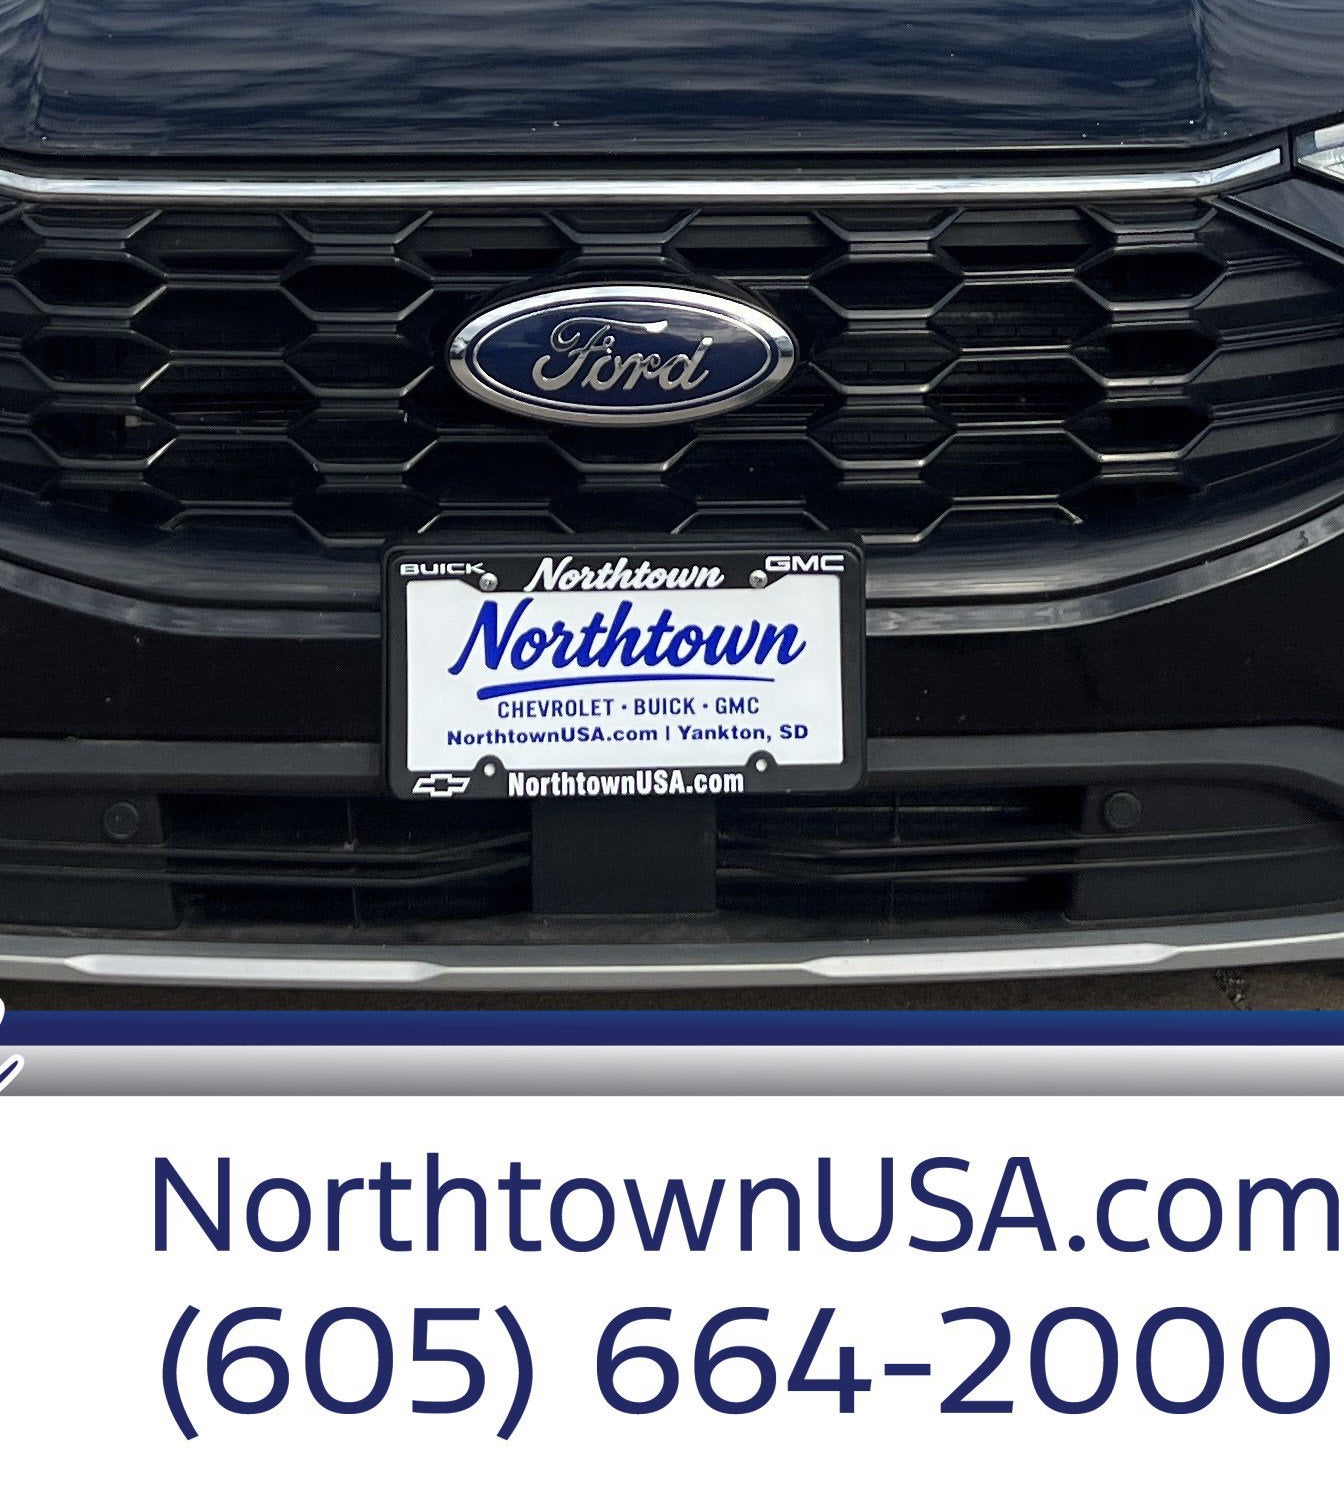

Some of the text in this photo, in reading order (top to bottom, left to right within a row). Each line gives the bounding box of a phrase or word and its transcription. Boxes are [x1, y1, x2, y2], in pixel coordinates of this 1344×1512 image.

[532, 316, 713, 391] Ford
[400, 562, 485, 576] BUICK
[523, 556, 725, 592] Northtown
[764, 554, 845, 572] GMC
[448, 597, 806, 675] Northtown
[498, 696, 760, 718] CHEVROLET BUICK GMC
[447, 724, 809, 746] NorthtownUSA.com Yankton, SD
[508, 771, 745, 797] NorthtownUSA.com
